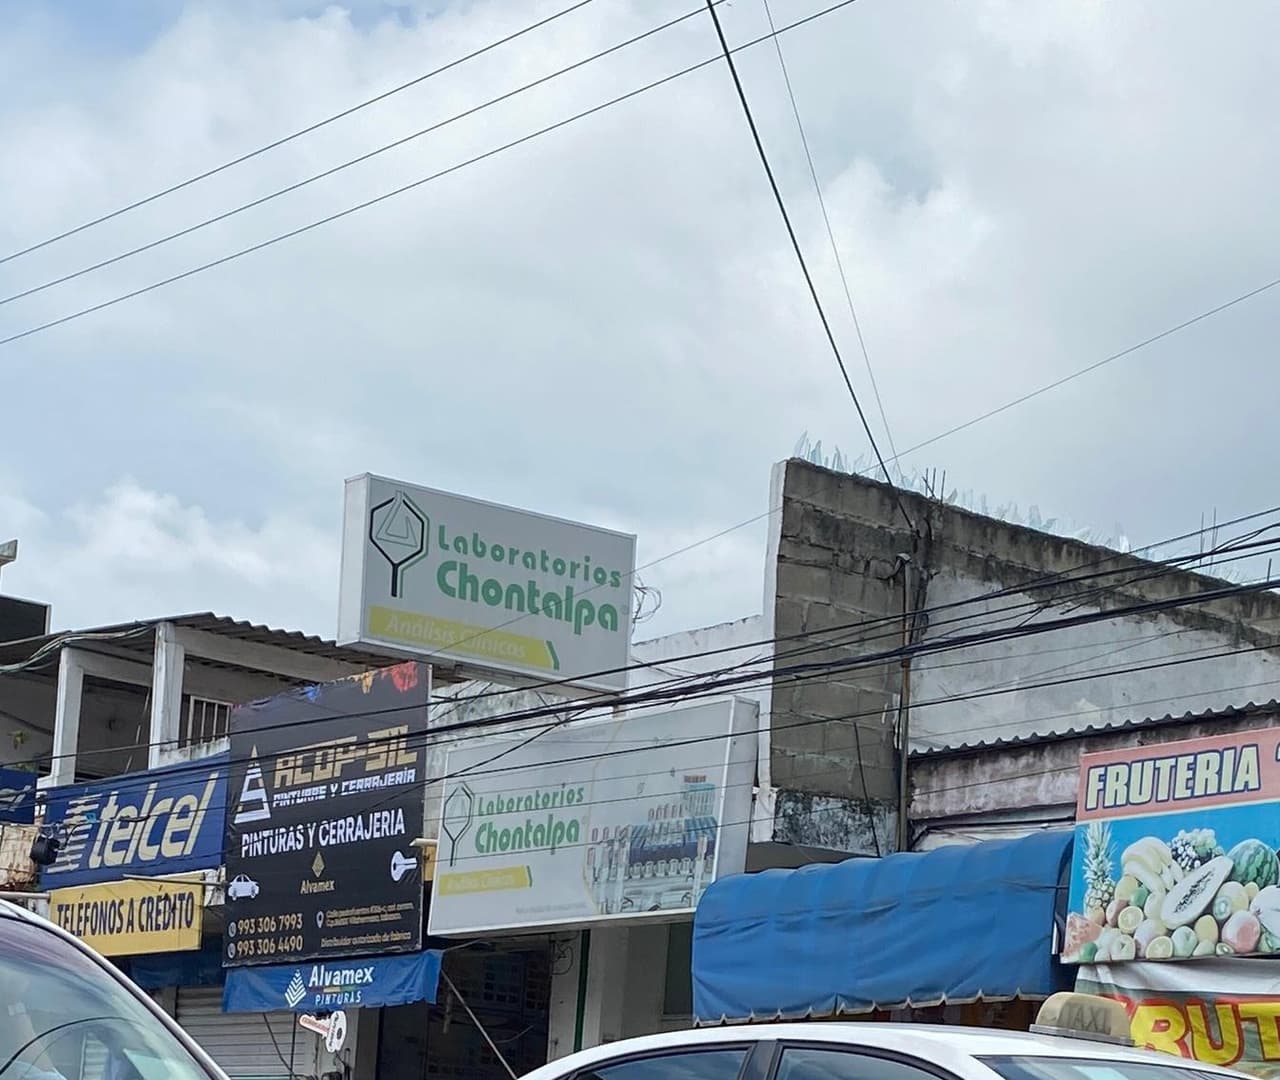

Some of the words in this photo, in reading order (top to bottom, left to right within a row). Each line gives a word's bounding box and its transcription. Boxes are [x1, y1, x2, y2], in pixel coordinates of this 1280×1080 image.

[439, 523, 622, 588] Laboratorios
[436, 560, 618, 635] Chontalpa
[1085, 744, 1262, 811] FRUTERIA
[477, 786, 585, 816] Laboratorios
[88, 771, 220, 869] telcel
[474, 813, 580, 855] Chontalpa
[241, 824, 304, 858] PINTURAS
[307, 821, 317, 849] Y
[299, 878, 336, 895] Alvamex
[57, 892, 124, 937] TELÉFONOS
[126, 897, 135, 934] A
[138, 884, 194, 933] CRÉDITO
[237, 917, 256, 935] 993
[256, 915, 277, 934] 306
[279, 912, 304, 931] 7993
[236, 938, 256, 956] 993
[256, 936, 277, 954] 306
[278, 934, 304, 953] 4490
[308, 965, 375, 988] Alvamex
[315, 990, 362, 1006] PINTURAS
